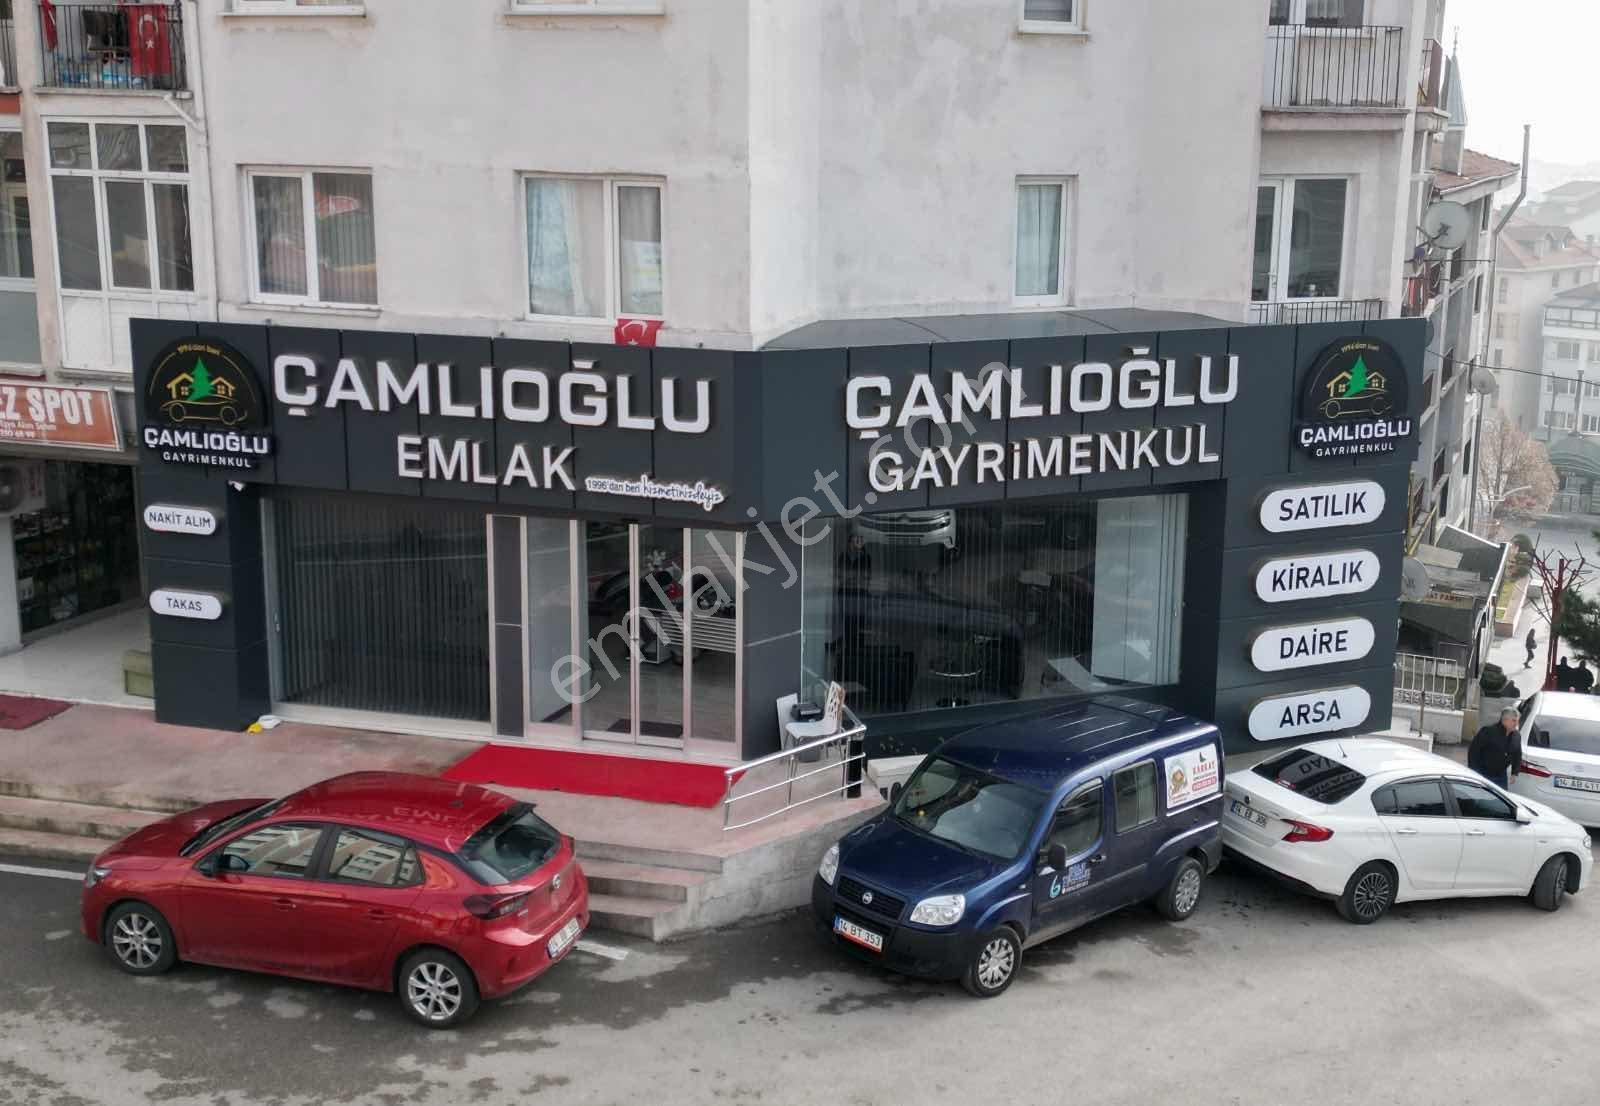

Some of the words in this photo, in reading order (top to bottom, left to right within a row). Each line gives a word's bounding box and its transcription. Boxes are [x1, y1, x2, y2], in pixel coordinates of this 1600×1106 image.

[27, 387, 94, 426] SPOT
[273, 354, 710, 434] ÇAMLIOĞLU
[846, 346, 1239, 439] ÇAMLIOĞLU
[143, 427, 269, 454] ÇAMLIOĞLU
[1300, 419, 1411, 447] ÇAMLIOĞLU
[397, 434, 577, 491] EMLAK
[149, 511, 182, 524] NAKİT
[185, 515, 211, 529] ALIM
[1278, 492, 1367, 522] SATILIK
[1271, 561, 1364, 592] KİRALIK
[166, 598, 202, 612] TAKAS
[1279, 628, 1349, 660] DAİRE
[1279, 700, 1342, 729] ARSA
[840, 920, 849, 932] 14
[850, 925, 862, 937] BT
[864, 931, 881, 946] 353
